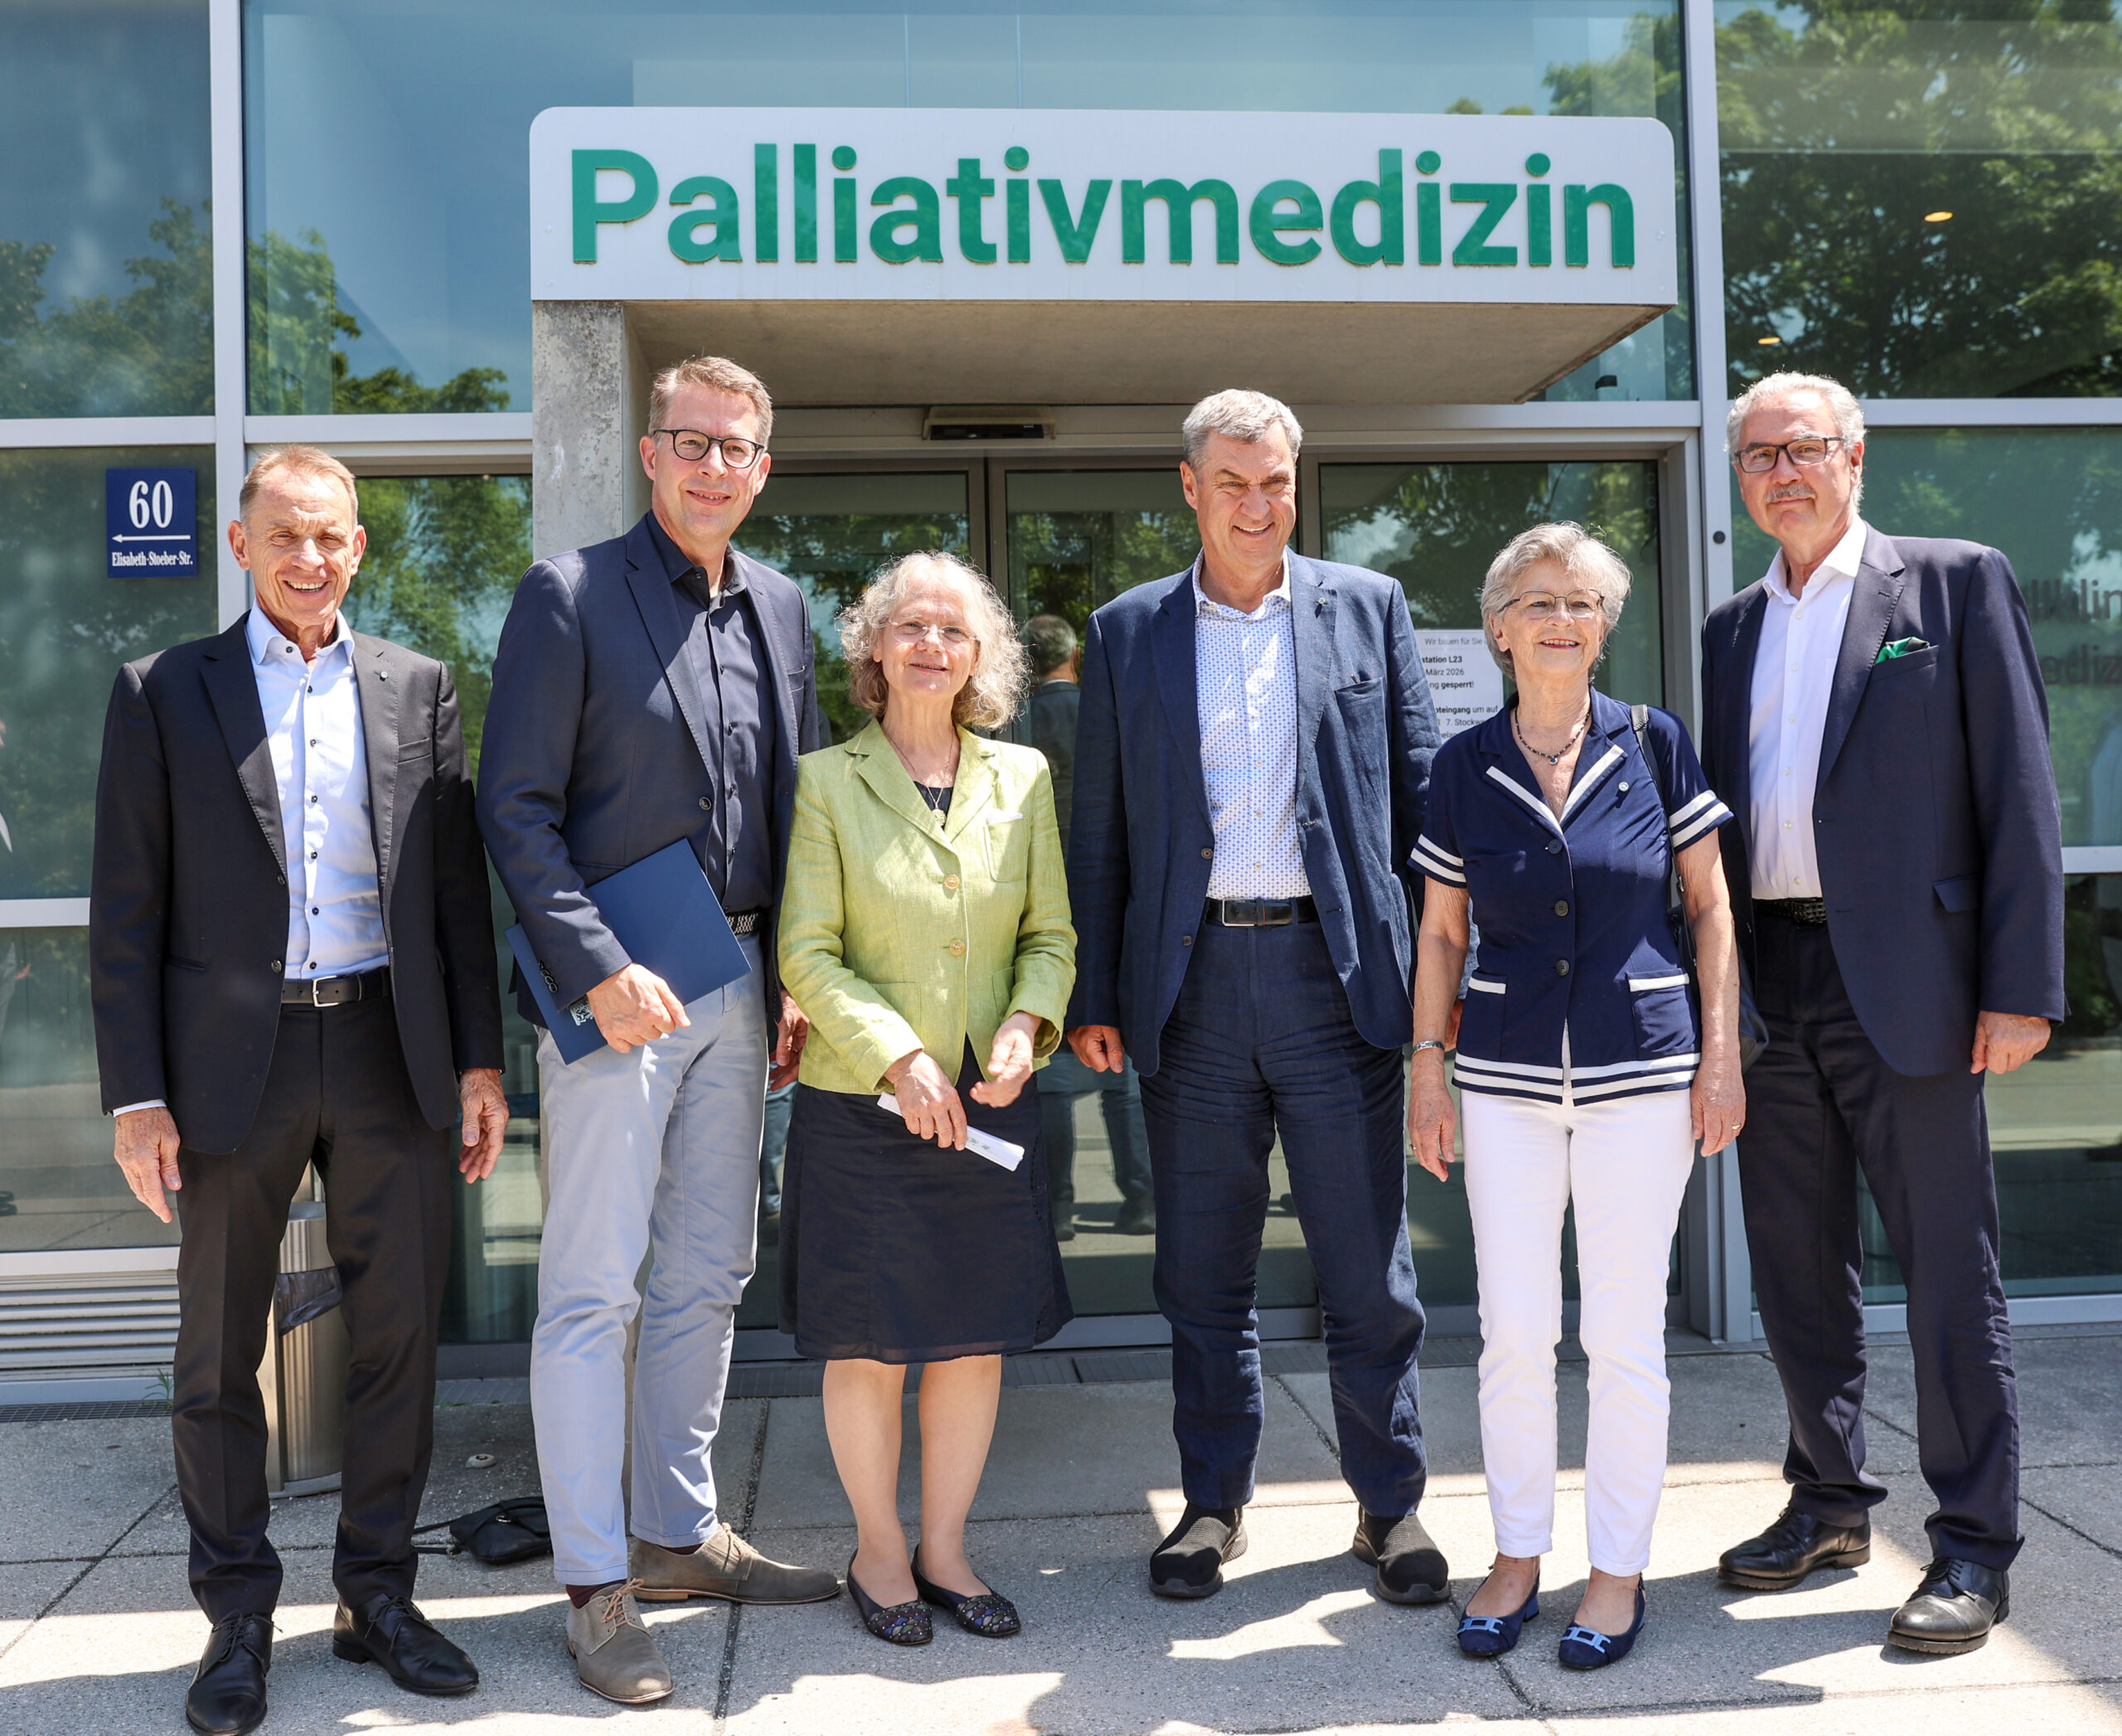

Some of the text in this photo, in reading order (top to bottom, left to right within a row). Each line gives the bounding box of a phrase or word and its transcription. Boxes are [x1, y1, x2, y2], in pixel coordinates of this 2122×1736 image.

[571, 143, 1635, 268] Palliativmedizin
[129, 480, 173, 529] 60
[111, 550, 193, 567] Elisabeth-Stoeber-Str.
[1441, 681, 1474, 690] gesperrt!
